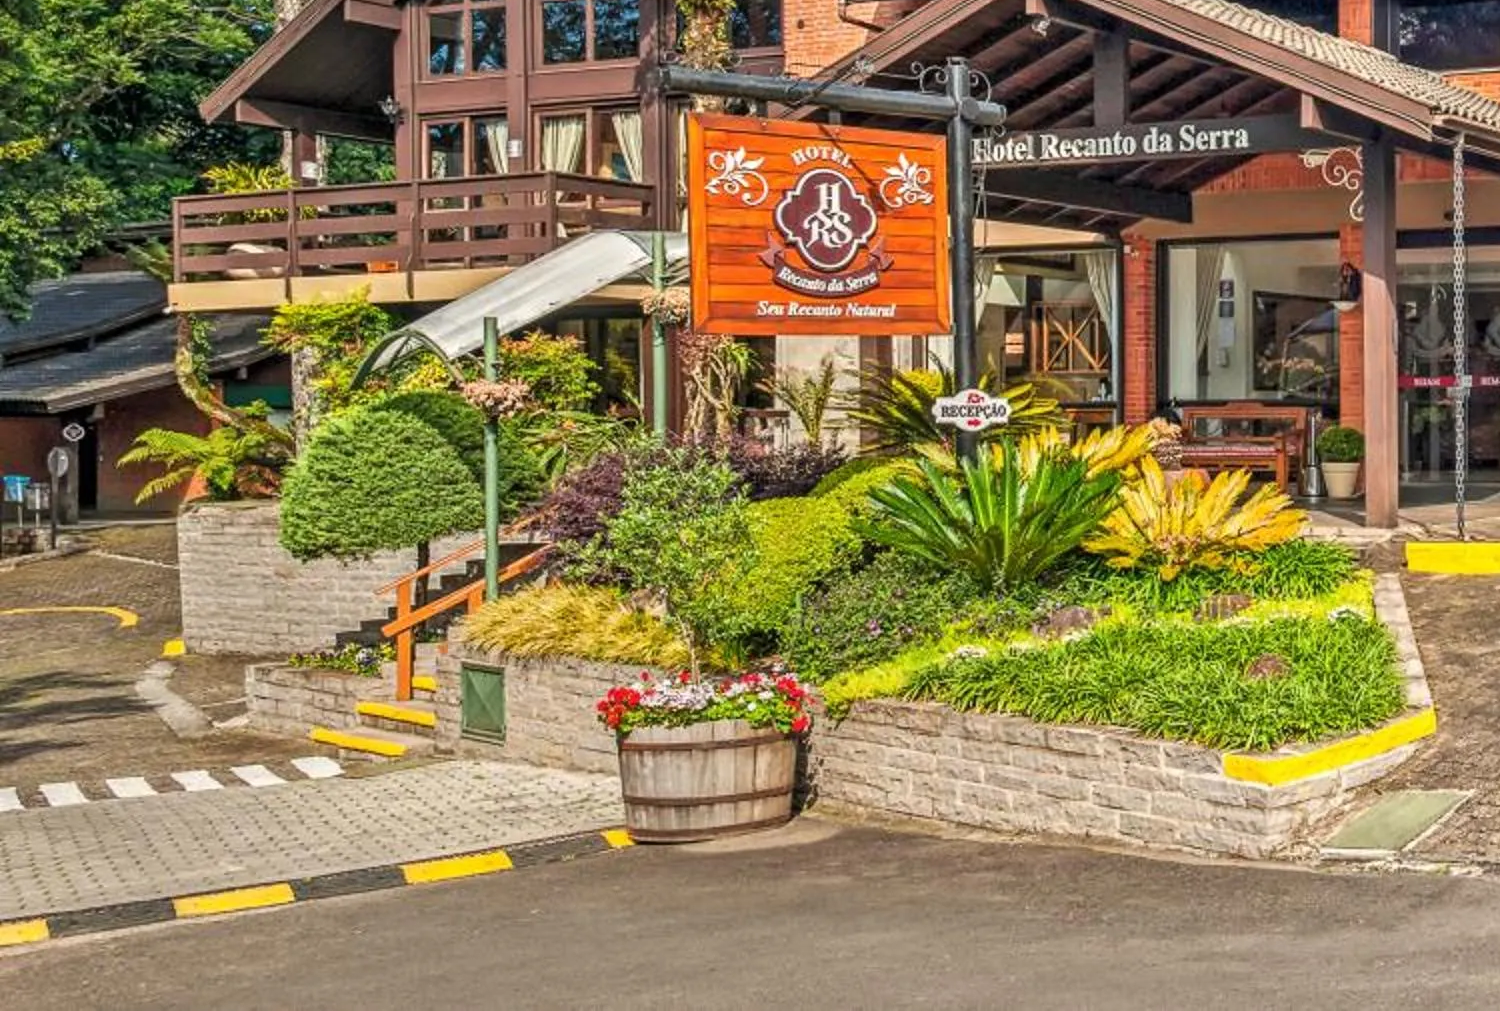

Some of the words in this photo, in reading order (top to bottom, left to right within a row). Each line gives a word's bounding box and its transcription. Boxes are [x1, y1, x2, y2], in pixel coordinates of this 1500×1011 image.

[971, 135, 1034, 164] Hotel
[1040, 133, 1135, 161] Recanto
[1143, 129, 1171, 155] da
[1179, 124, 1249, 152] Serra
[790, 146, 853, 169] HOTEL
[827, 278, 845, 292] da
[757, 300, 785, 317] Seu
[787, 301, 843, 318] Recanto
[845, 302, 897, 318] Natural
[941, 403, 1007, 419] RECEPÇÃO
